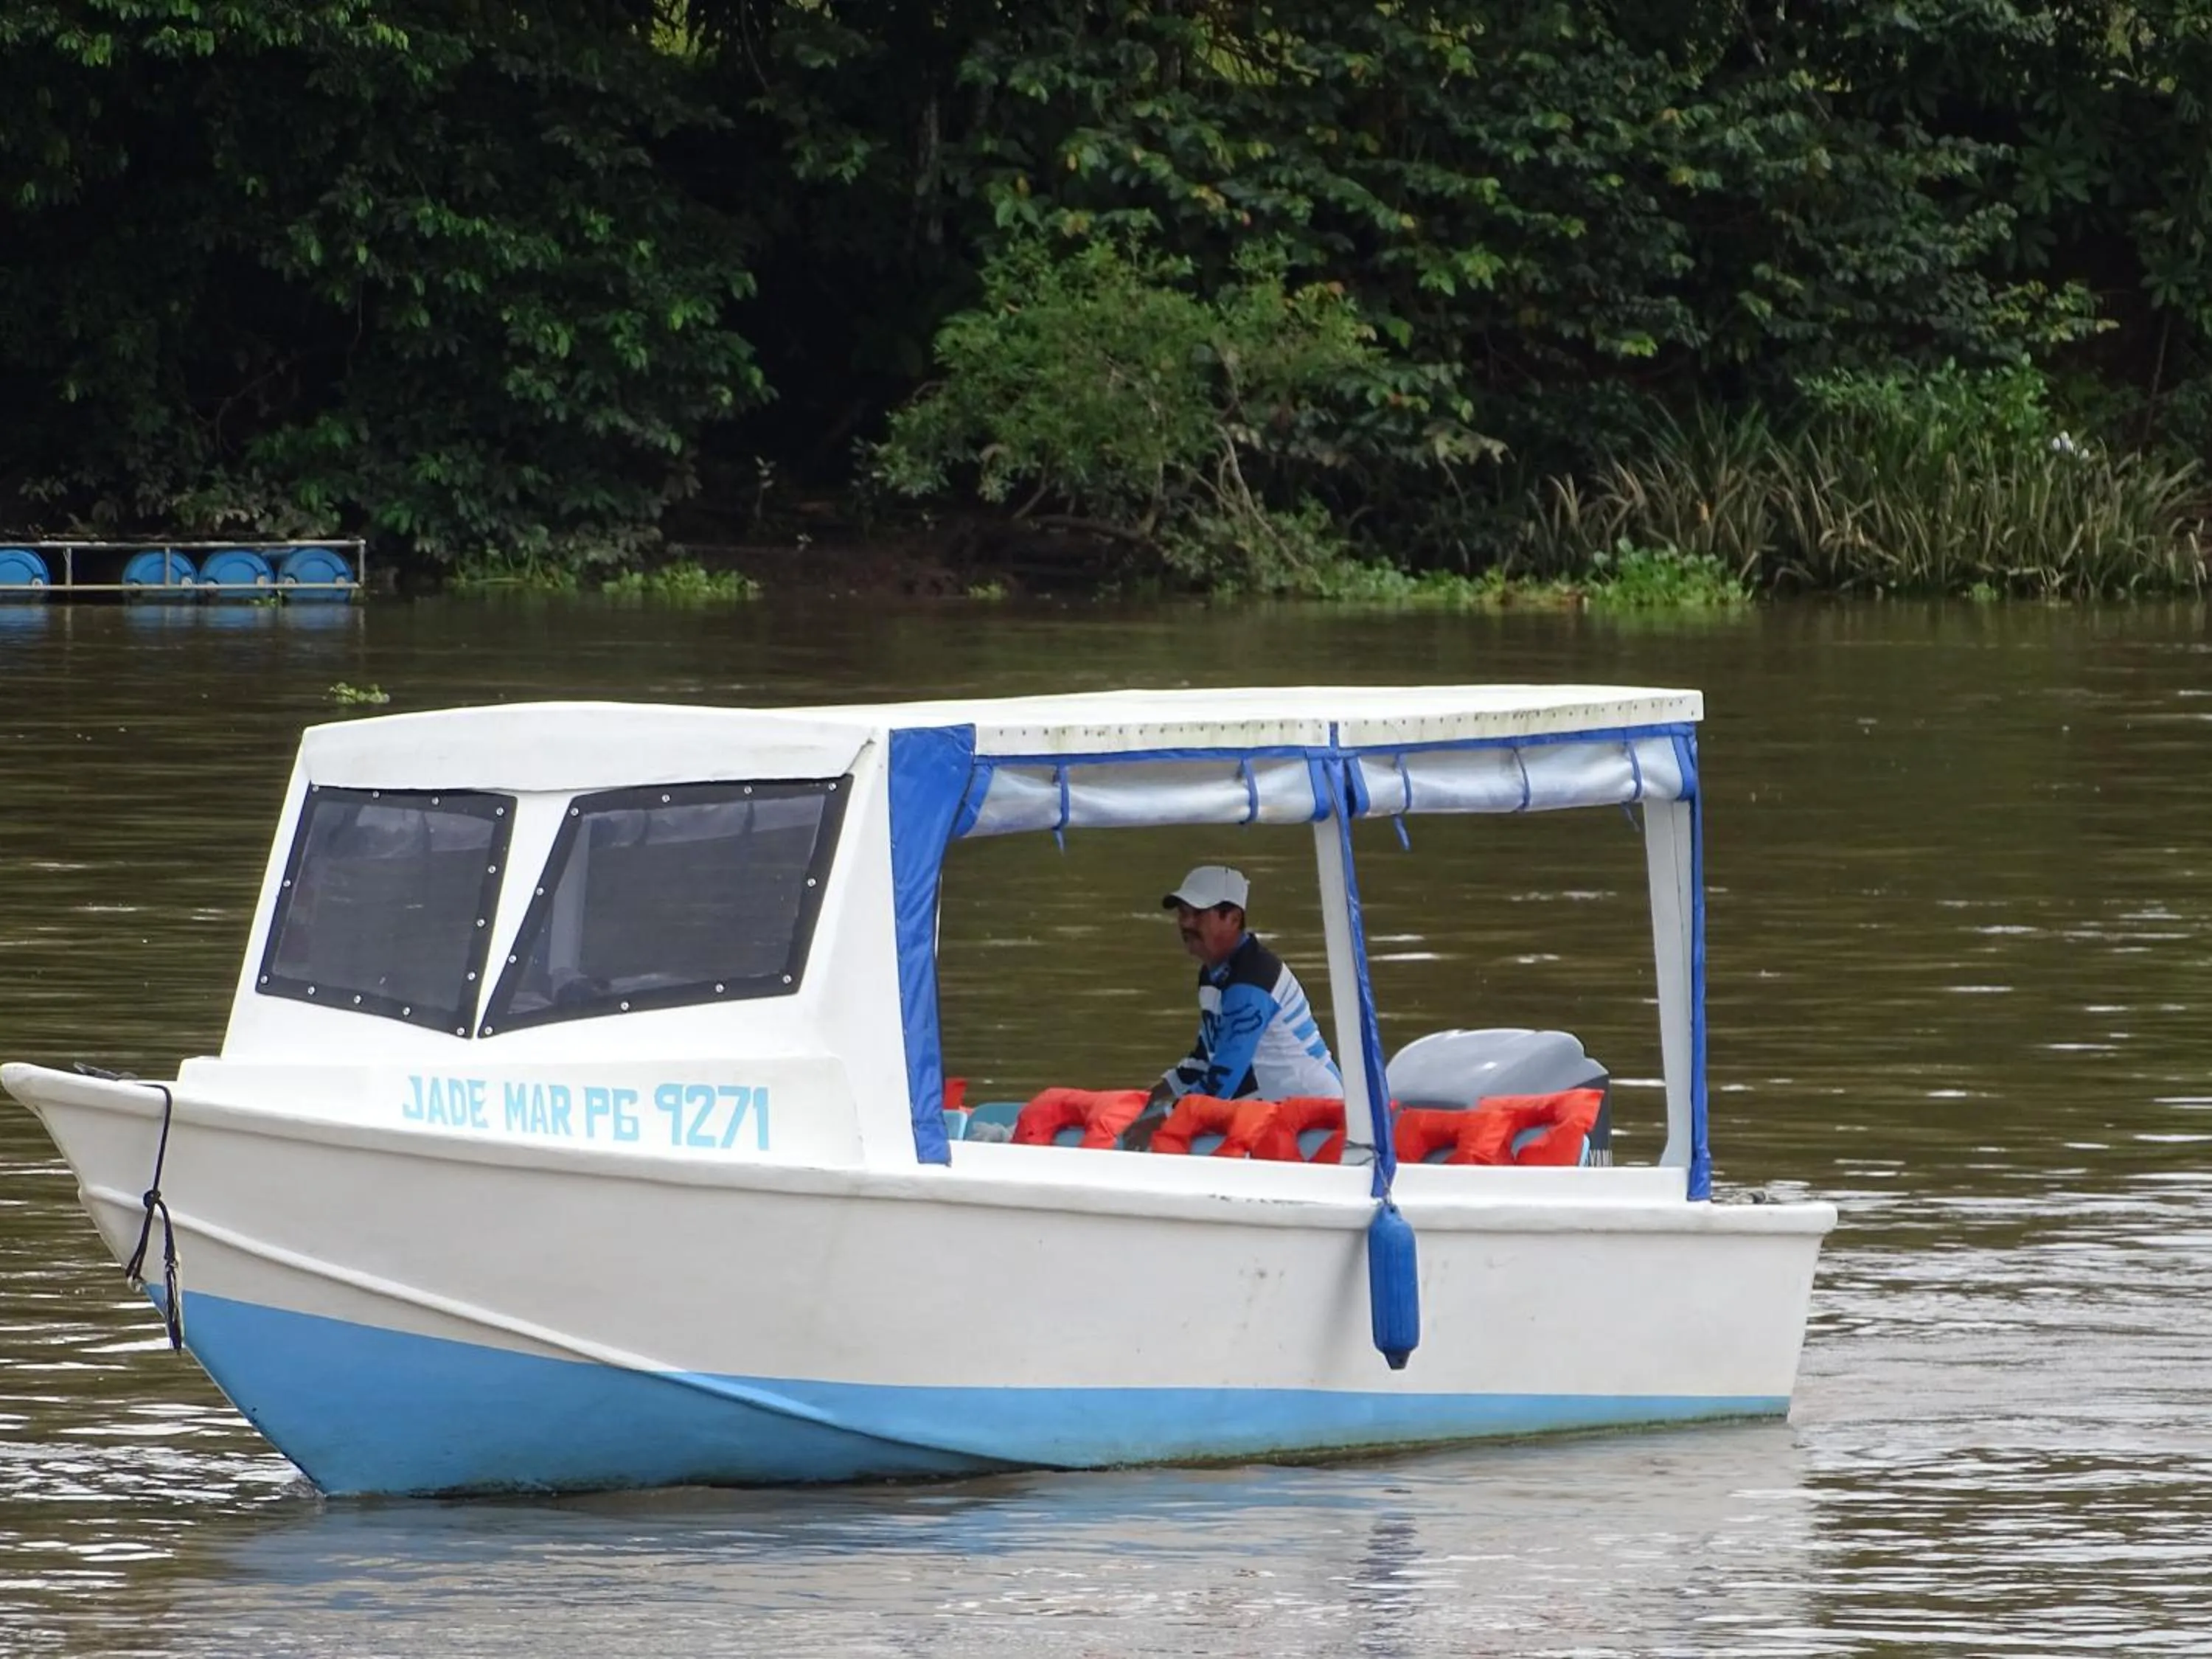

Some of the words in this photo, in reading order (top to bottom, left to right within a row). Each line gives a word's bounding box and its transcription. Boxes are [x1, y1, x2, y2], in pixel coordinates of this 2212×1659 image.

[403, 1076, 489, 1129] JADE
[504, 1082, 574, 1136] MAR
[654, 1083, 770, 1151] 9271
